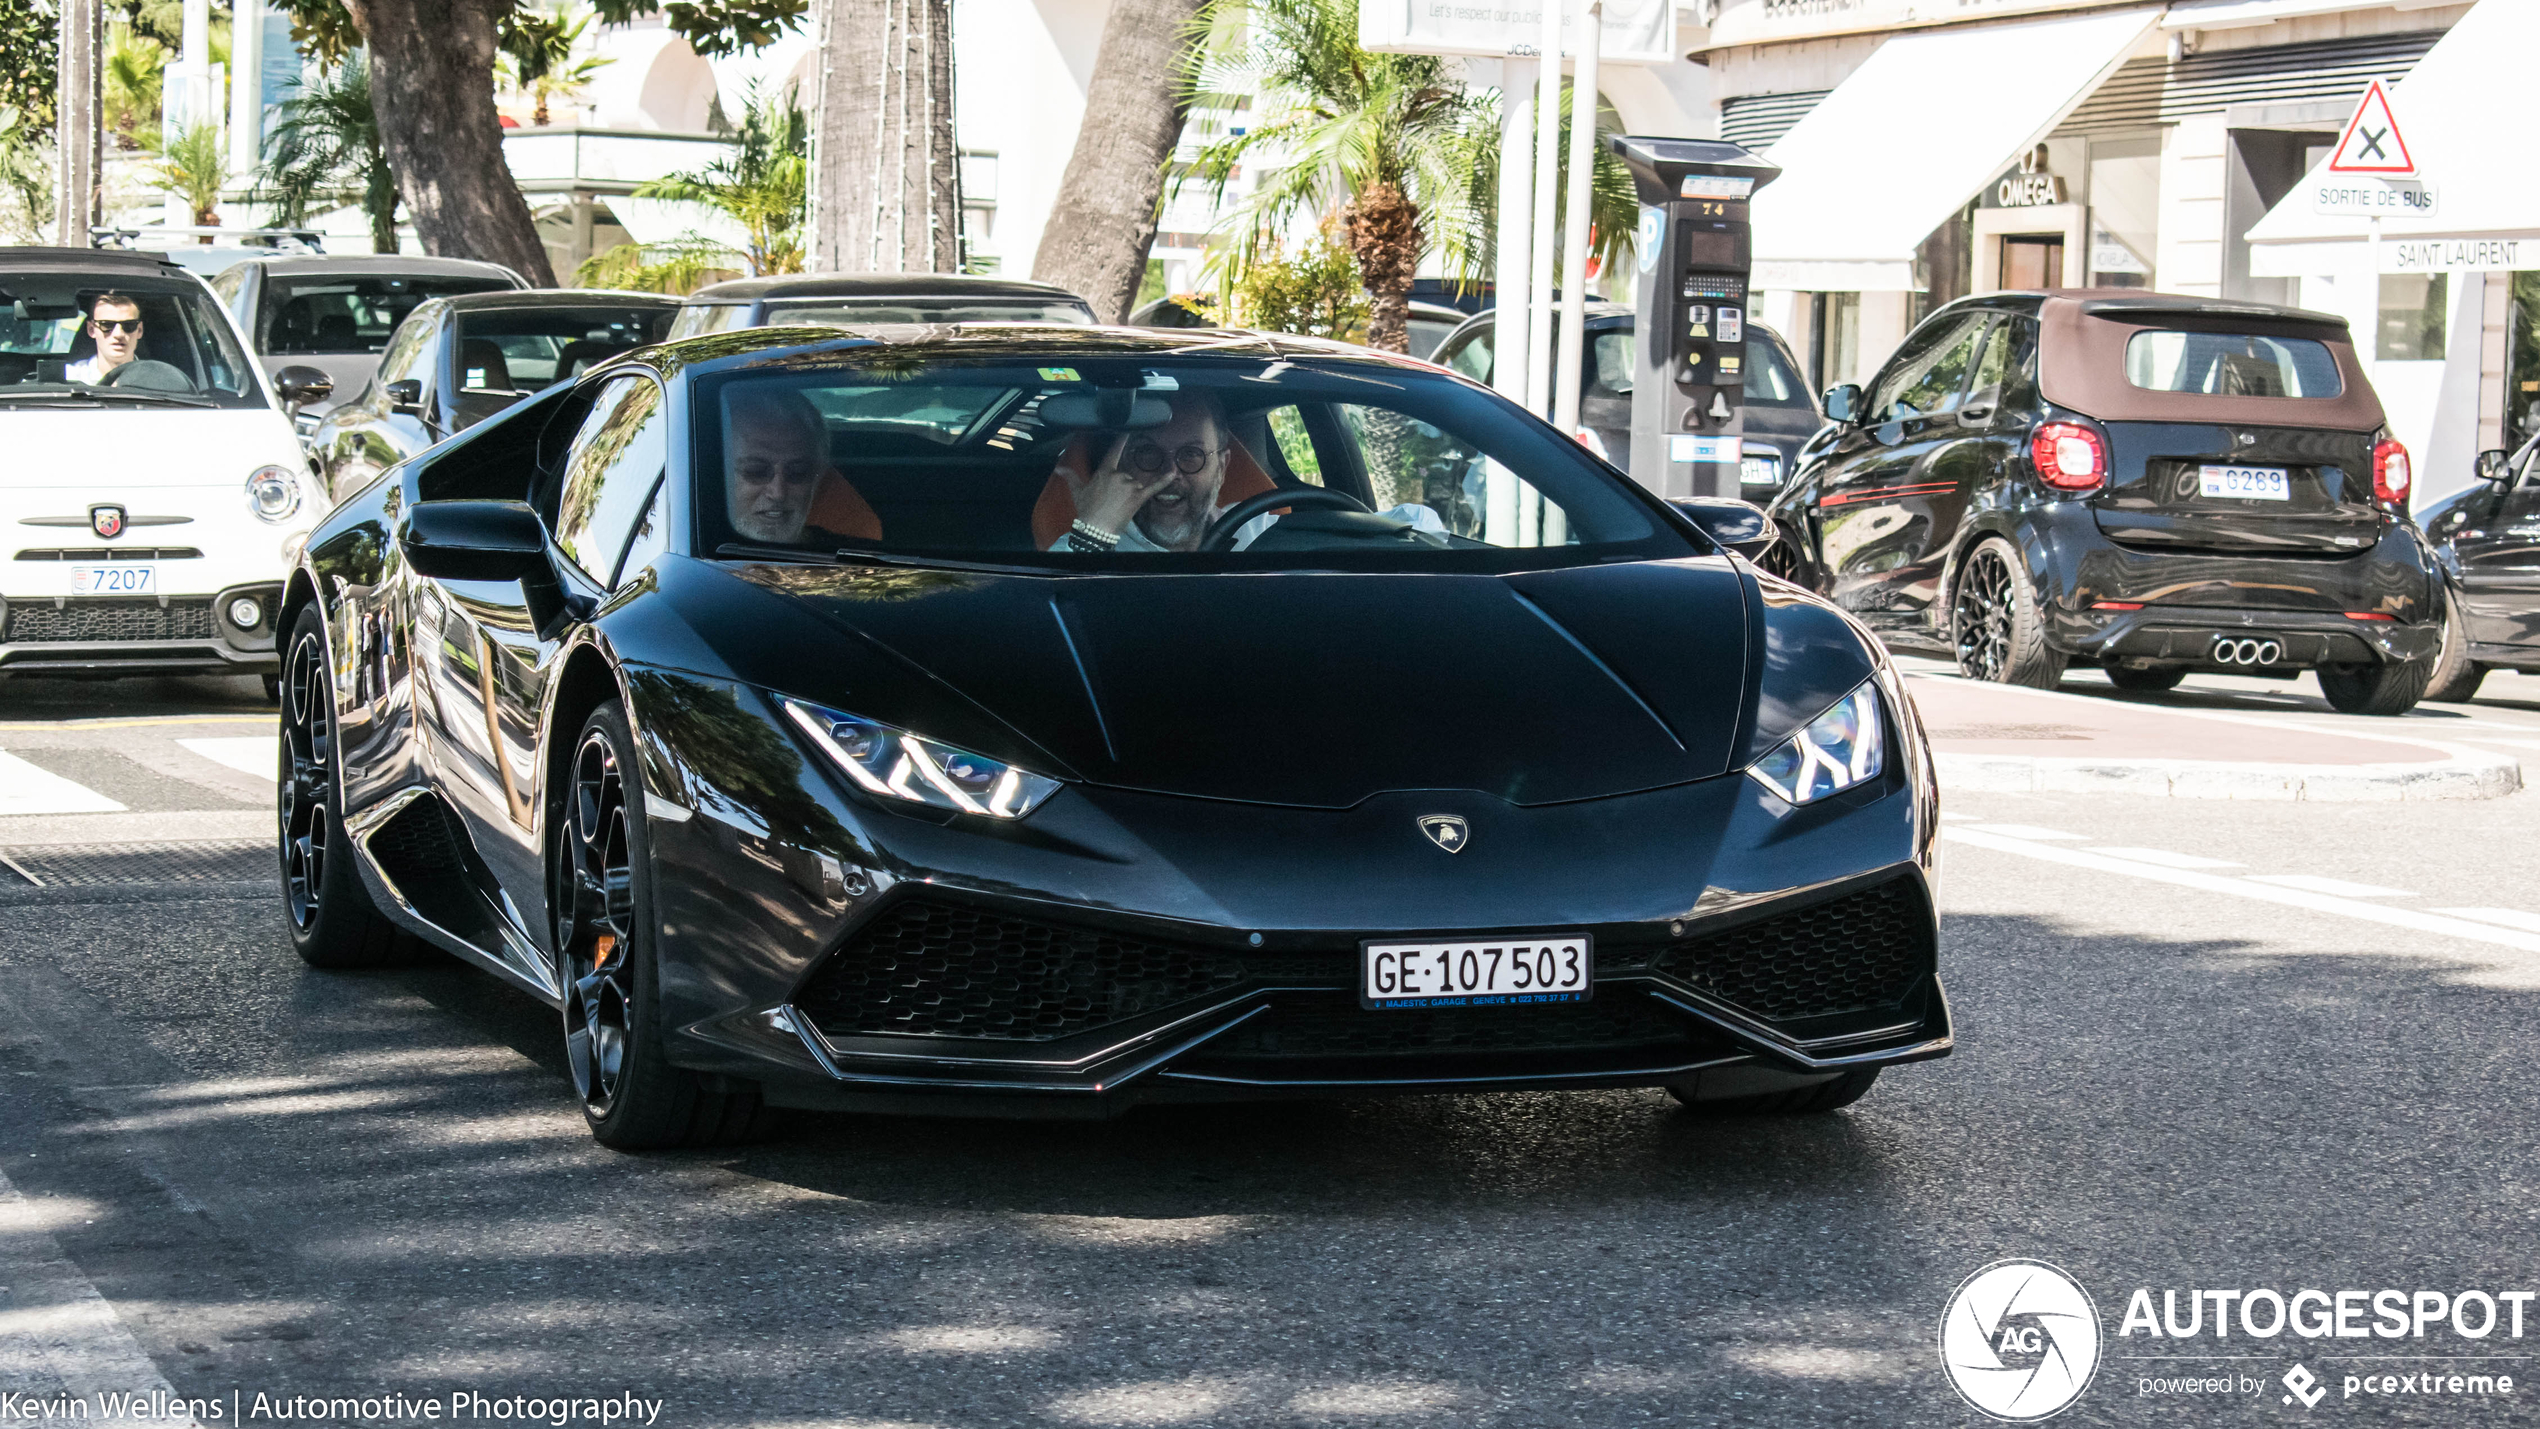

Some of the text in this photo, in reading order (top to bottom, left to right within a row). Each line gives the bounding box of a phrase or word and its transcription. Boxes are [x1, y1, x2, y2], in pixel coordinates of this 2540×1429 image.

[1429, 2, 1452, 18] Let's
[1453, 7, 1491, 24] respect
[1493, 10, 1509, 22] our
[1998, 177, 2058, 207] OMEGA
[2319, 188, 2433, 208] SORTIE DE BUS
[1641, 215, 1658, 261] P
[2397, 241, 2518, 267] SAINT LAURENT
[2226, 470, 2281, 492] G269
[93, 569, 150, 590] 7207
[1386, 998, 1427, 1008] MAJESTIC
[1431, 997, 1467, 1006] GARAGE
[1518, 994, 1532, 1003] 022
[1549, 994, 1559, 1002] 37
[1559, 993, 1569, 1002] 37
